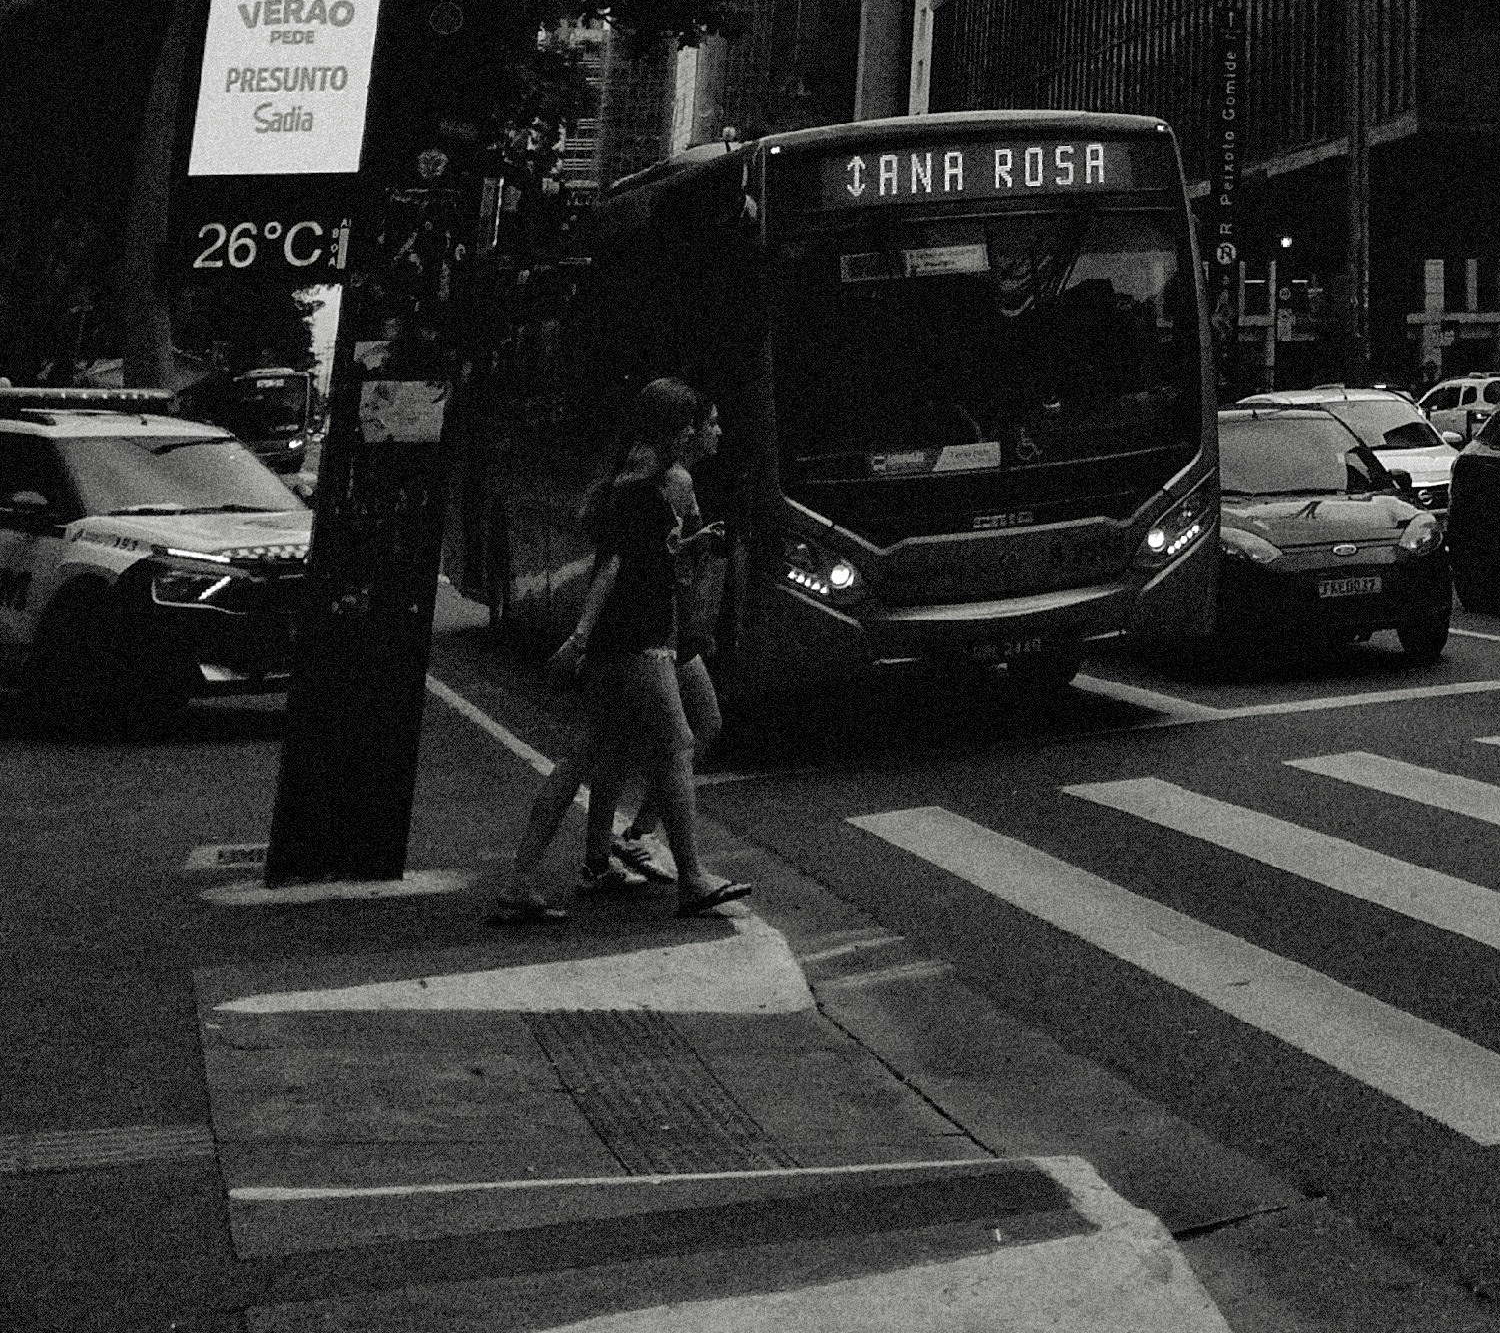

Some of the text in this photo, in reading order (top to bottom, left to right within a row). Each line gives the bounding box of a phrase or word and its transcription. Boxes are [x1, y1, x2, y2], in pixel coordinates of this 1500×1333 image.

[269, 30, 316, 45] PEDE
[225, 65, 349, 93] PRESUNTO
[1222, 51, 1238, 121] Gomide
[253, 101, 315, 133] Sadia
[878, 142, 1105, 198] ANA ROSA
[1220, 130, 1236, 206] Peixoto
[191, 220, 325, 270] 26°C
